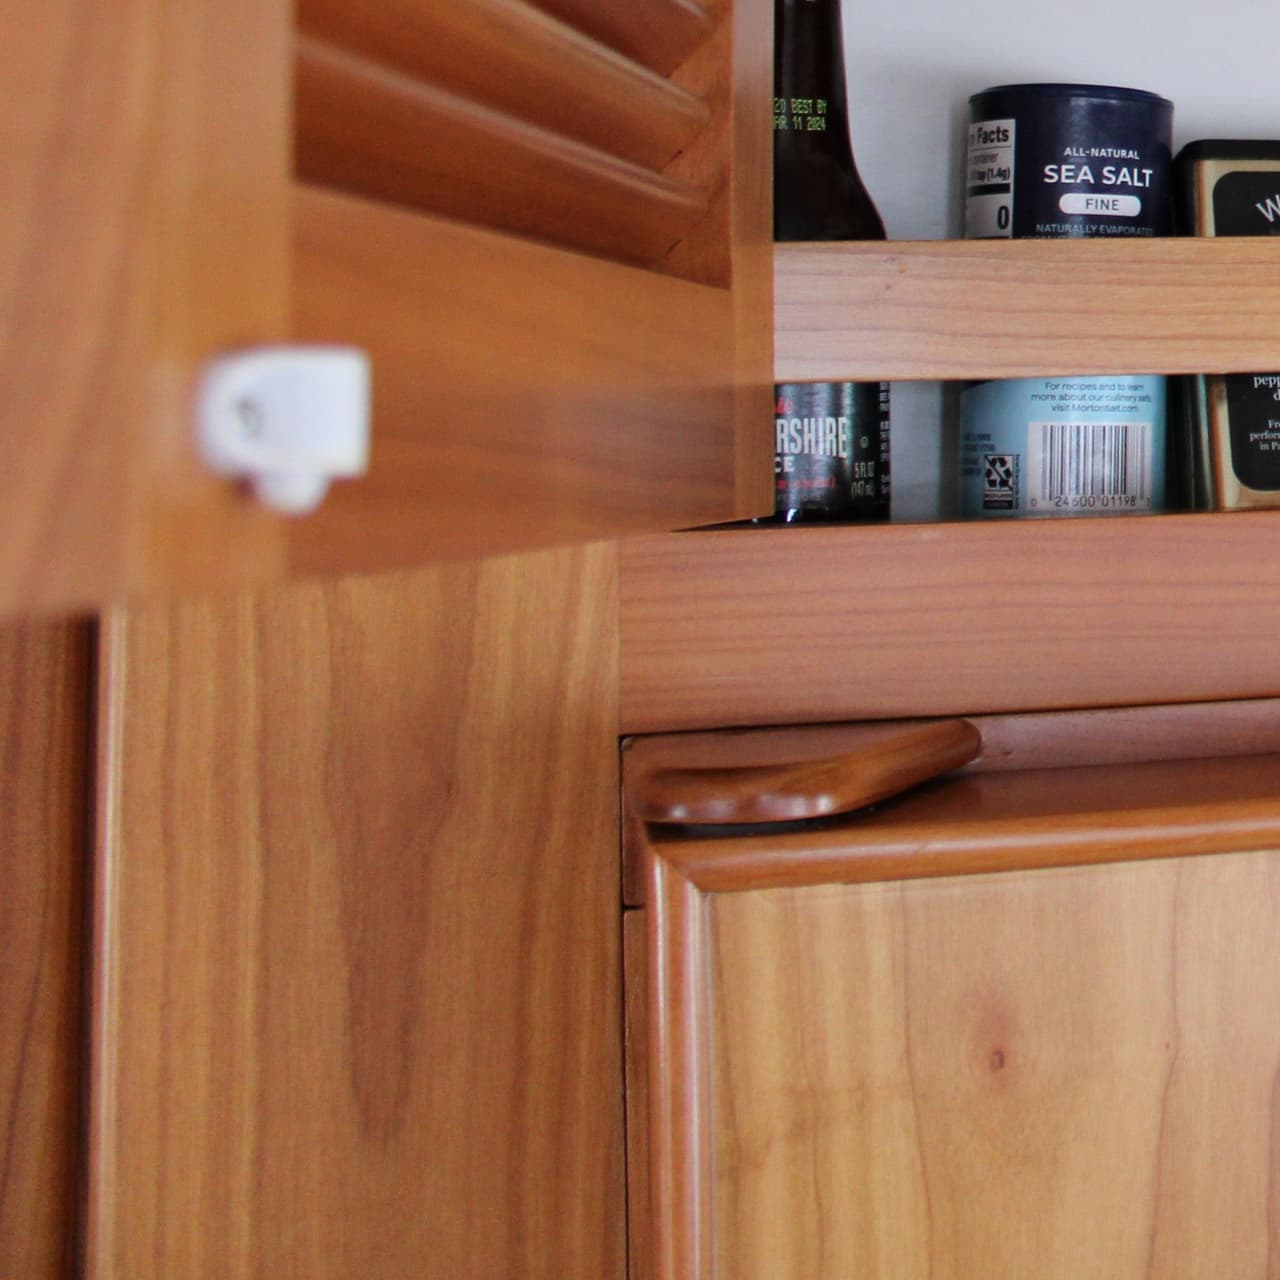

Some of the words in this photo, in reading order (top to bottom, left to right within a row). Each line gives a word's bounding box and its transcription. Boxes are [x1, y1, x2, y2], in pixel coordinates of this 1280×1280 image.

[791, 98, 813, 114] BEST
[976, 125, 1010, 145] Facts
[1063, 146, 1141, 160] ALL-NATURAL
[1043, 164, 1095, 184] SEA
[1101, 166, 1153, 188] SALT
[1085, 197, 1121, 212] FINE
[996, 205, 1009, 230] 0
[1036, 223, 1098, 235] NATURALLY
[1044, 381, 1061, 391] For
[1061, 381, 1098, 392] recipes
[1099, 381, 1115, 391] and
[1116, 382, 1127, 391] to
[1031, 393, 1057, 402] more
[1058, 392, 1087, 402] about
[1088, 394, 1104, 402] our
[1104, 392, 1138, 404] culinary
[1051, 404, 1070, 413] visit
[776, 416, 849, 458] RSHIRE
[1259, 441, 1270, 451] in
[1030, 499, 1037, 508] 0
[1102, 495, 1137, 507] 01198
